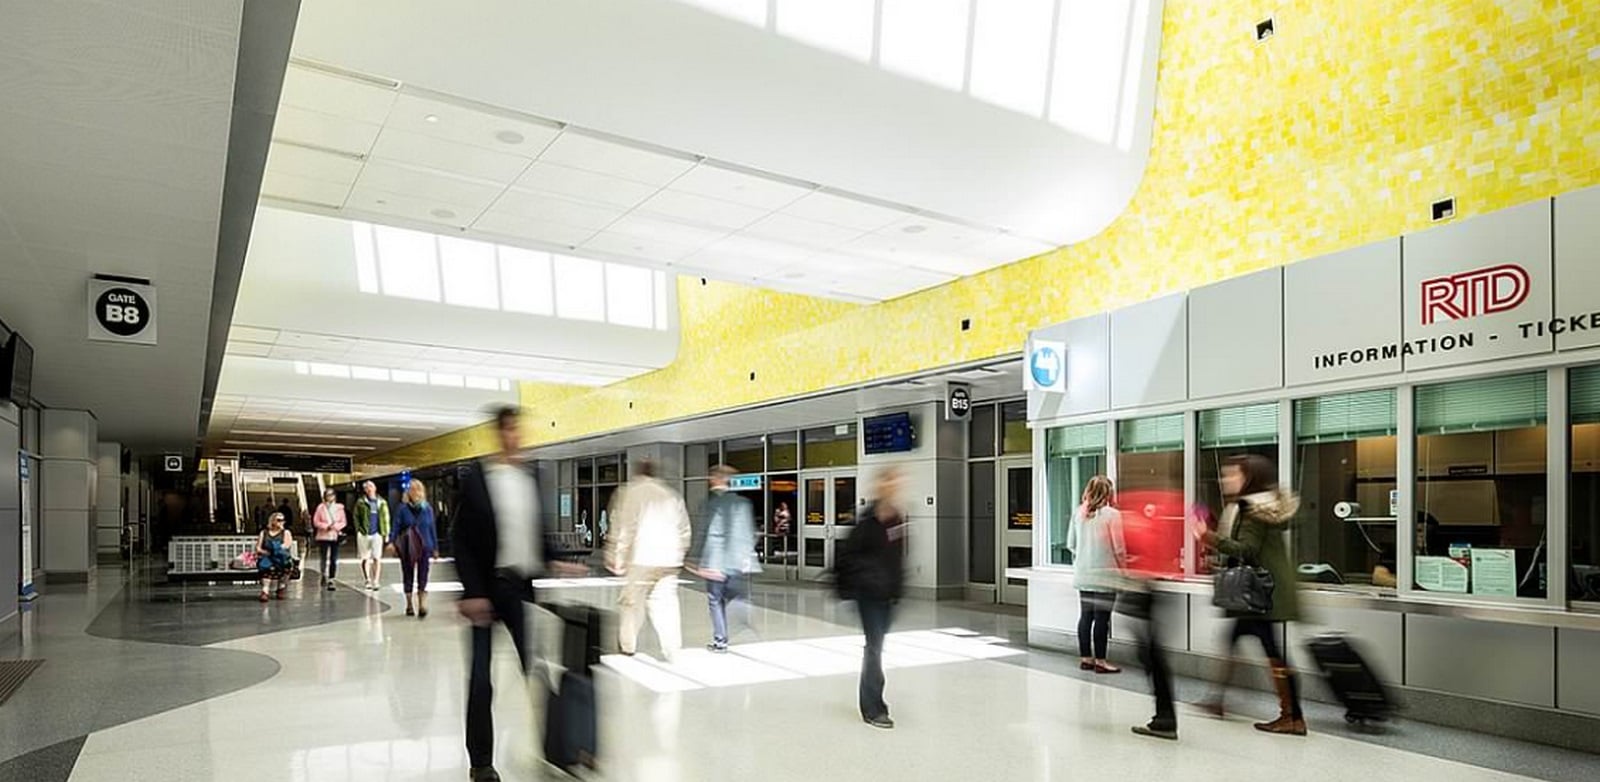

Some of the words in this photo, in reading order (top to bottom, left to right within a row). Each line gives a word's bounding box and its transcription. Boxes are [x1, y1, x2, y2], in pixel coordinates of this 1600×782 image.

[108, 293, 136, 304] GATE
[1421, 264, 1531, 325] RTD
[106, 305, 140, 324] B8
[1315, 333, 1474, 369] INFORMATION
[1518, 312, 1600, 339] TICKE
[952, 398, 968, 410] B15
